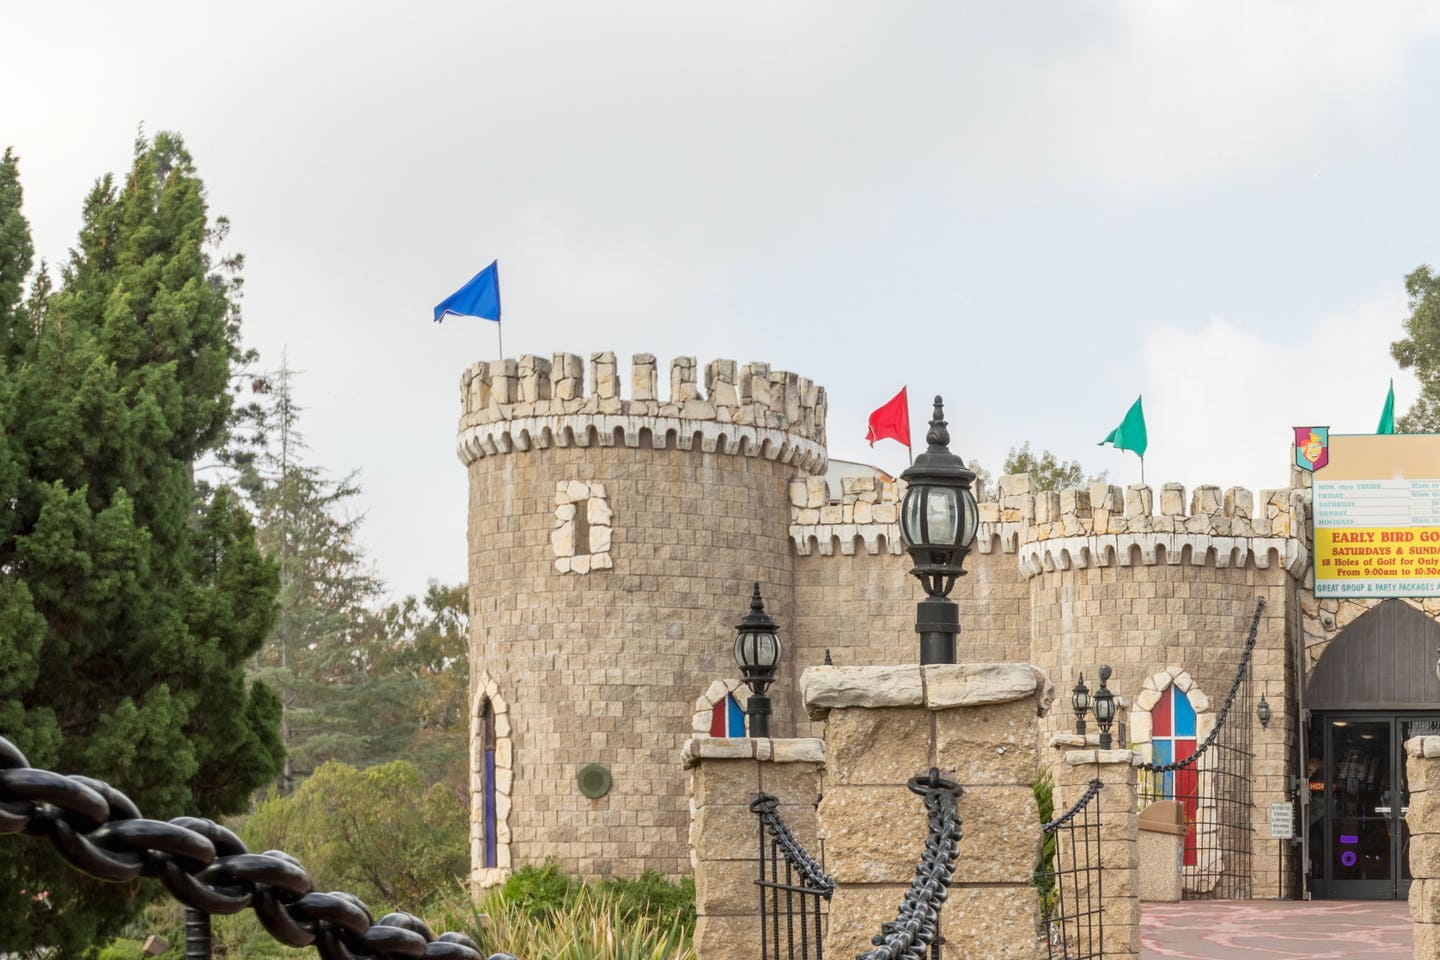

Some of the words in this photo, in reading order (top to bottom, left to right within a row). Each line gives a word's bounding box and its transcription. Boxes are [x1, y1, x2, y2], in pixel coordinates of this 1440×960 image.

[1332, 532, 1375, 543] EARLY
[1381, 532, 1414, 542] BIRD
[1332, 547, 1391, 556] SATURDAYS
[1396, 547, 1404, 555] &
[1363, 558, 1373, 566] of
[1377, 558, 1396, 566] Golf
[1418, 558, 1439, 567] Only
[1337, 568, 1360, 576] From
[1364, 568, 1398, 576] 9:00am
[1402, 568, 1410, 576] to
[1317, 584, 1339, 592] GREAT
[1341, 584, 1365, 592] GROUP
[1367, 583, 1373, 591] &
[1376, 583, 1397, 591] PARTY
